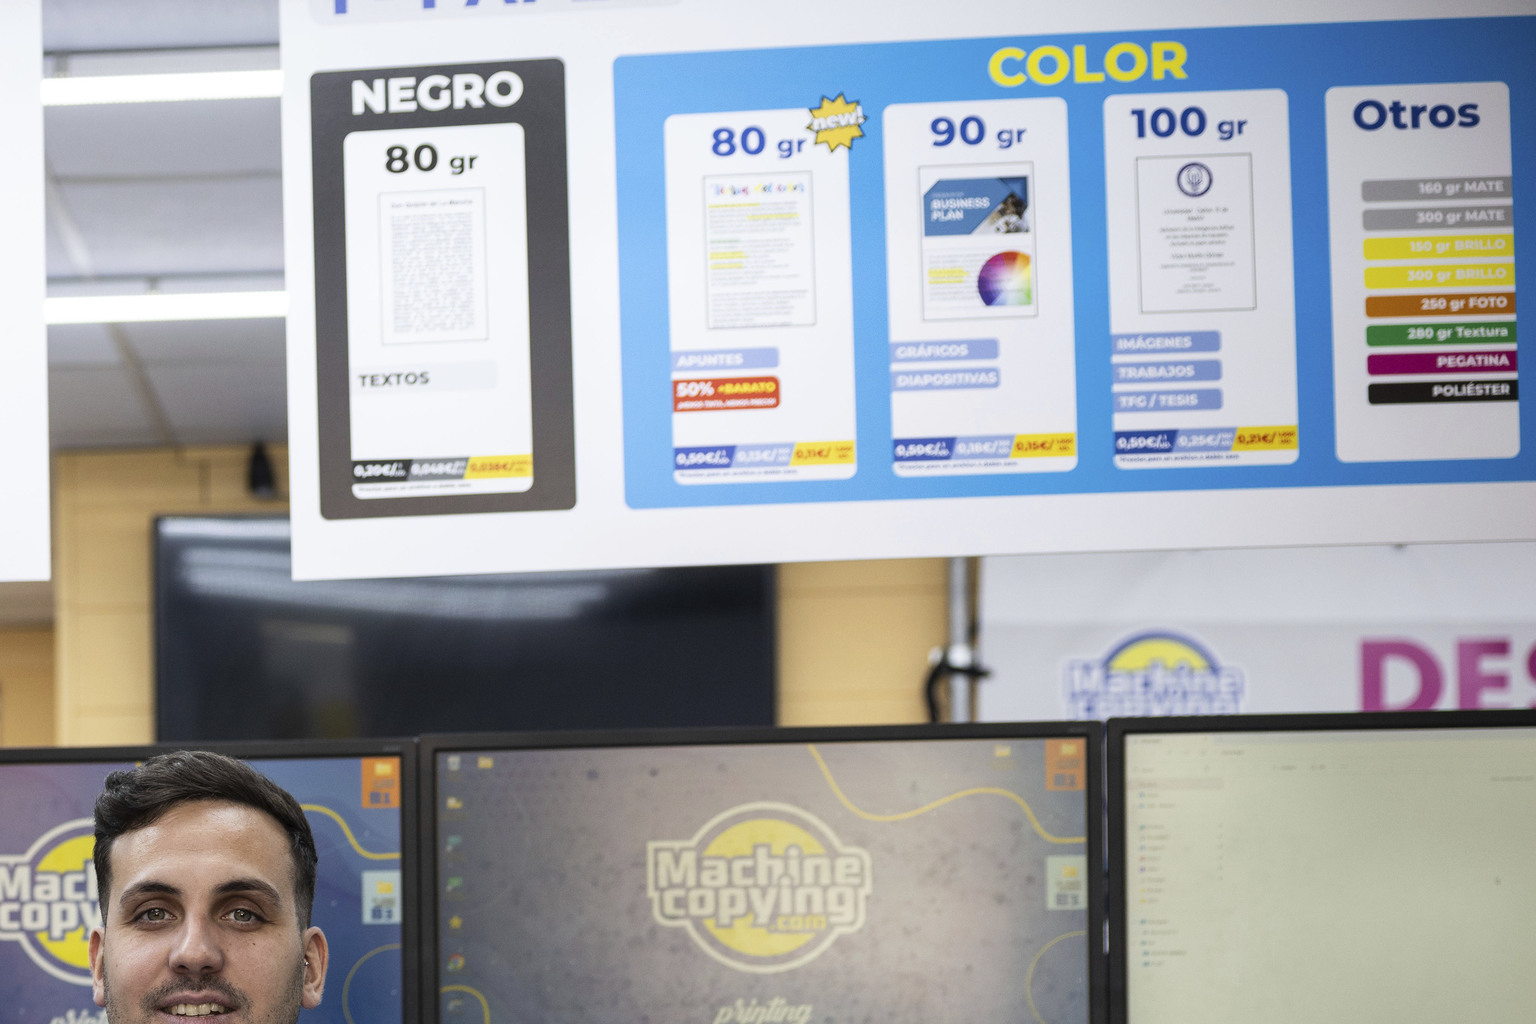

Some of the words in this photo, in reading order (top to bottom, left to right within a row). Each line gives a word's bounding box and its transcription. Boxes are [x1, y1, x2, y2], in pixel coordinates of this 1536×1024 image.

[988, 41, 1188, 87] COLOR
[351, 71, 524, 115] NEGRO
[810, 106, 864, 132] new!
[1353, 99, 1480, 130] Otros
[930, 115, 986, 147] 90
[997, 124, 1026, 149] gr
[1132, 107, 1206, 139] 100
[1217, 115, 1247, 141] gr
[711, 126, 765, 156] 80
[777, 136, 807, 160] gr
[385, 144, 439, 173] 80
[449, 152, 479, 175] gr
[1419, 182, 1441, 194] 160
[1446, 185, 1461, 197] gr
[1465, 181, 1504, 192] MATE
[1416, 211, 1442, 223] 300
[1446, 214, 1462, 226] gr
[1465, 210, 1505, 222] MATE
[1410, 241, 1432, 252] 150
[1436, 243, 1451, 254] gr
[1455, 239, 1505, 250] BRILLO
[1408, 270, 1433, 281] 300
[1437, 273, 1451, 284] gr
[1456, 268, 1506, 280] BRILLO
[1421, 298, 1446, 310] 250
[1451, 301, 1465, 312] gr
[1469, 296, 1507, 308] FOTO
[1407, 328, 1433, 339] 280
[1437, 330, 1452, 341] gr
[1456, 326, 1508, 337] Textura
[896, 343, 968, 358] GRÁFICOS
[1118, 336, 1192, 350] IMÁGENES
[677, 354, 743, 367] APUNTES
[1437, 355, 1509, 368] PEGATINA
[359, 370, 430, 388] TEXTOS
[897, 371, 997, 387] DIAPOSITIVAS
[1119, 365, 1194, 379] TRABAJOS
[677, 382, 714, 398] 50%
[1433, 381, 1510, 397] POLIÉSTER
[1160, 394, 1198, 406] TESIS
[657, 846, 862, 888] Machine
[663, 876, 855, 925] copying
[770, 915, 826, 930] .com
